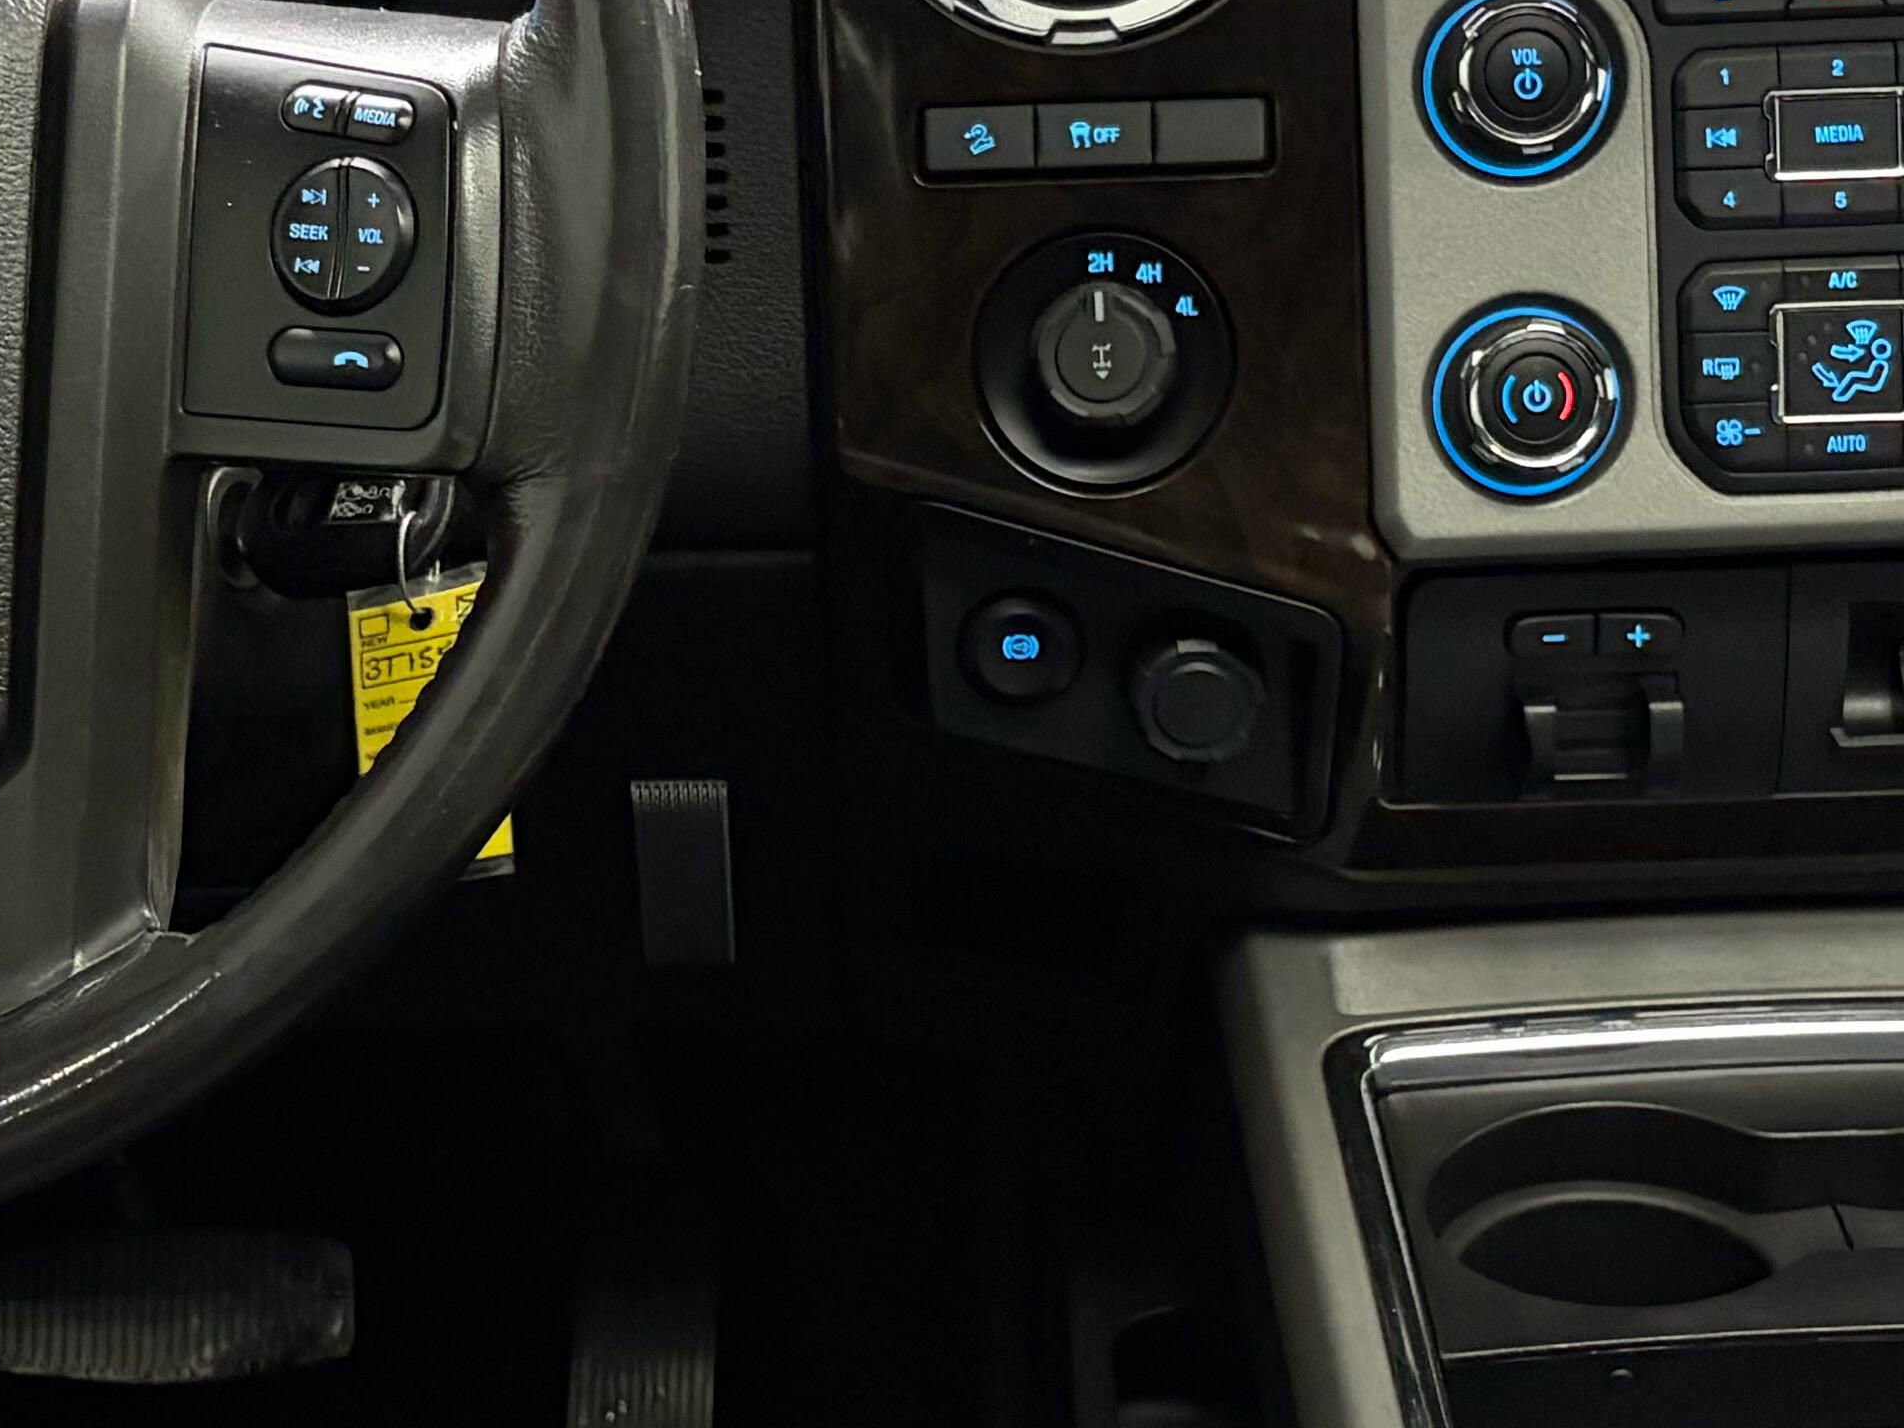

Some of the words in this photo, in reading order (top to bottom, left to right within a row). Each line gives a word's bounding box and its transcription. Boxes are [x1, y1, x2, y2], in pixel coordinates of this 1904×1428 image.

[1511, 48, 1542, 66] VOL
[1720, 67, 1731, 85] 1
[1831, 59, 1845, 77] 2
[353, 106, 396, 128] MEDIA
[1093, 126, 1121, 145] OFF
[1814, 123, 1864, 145] MEDIA
[1722, 191, 1736, 209] 4
[1834, 191, 1848, 209] 5
[289, 223, 328, 242] SEEK
[358, 228, 384, 245] VOL
[1088, 252, 1114, 273] 2H
[1135, 262, 1163, 284] 4H
[1828, 271, 1858, 290] A/C
[1175, 296, 1200, 317] 4L
[1702, 359, 1714, 377] R
[1826, 434, 1867, 454] AUTO
[361, 637, 389, 649] NEW
